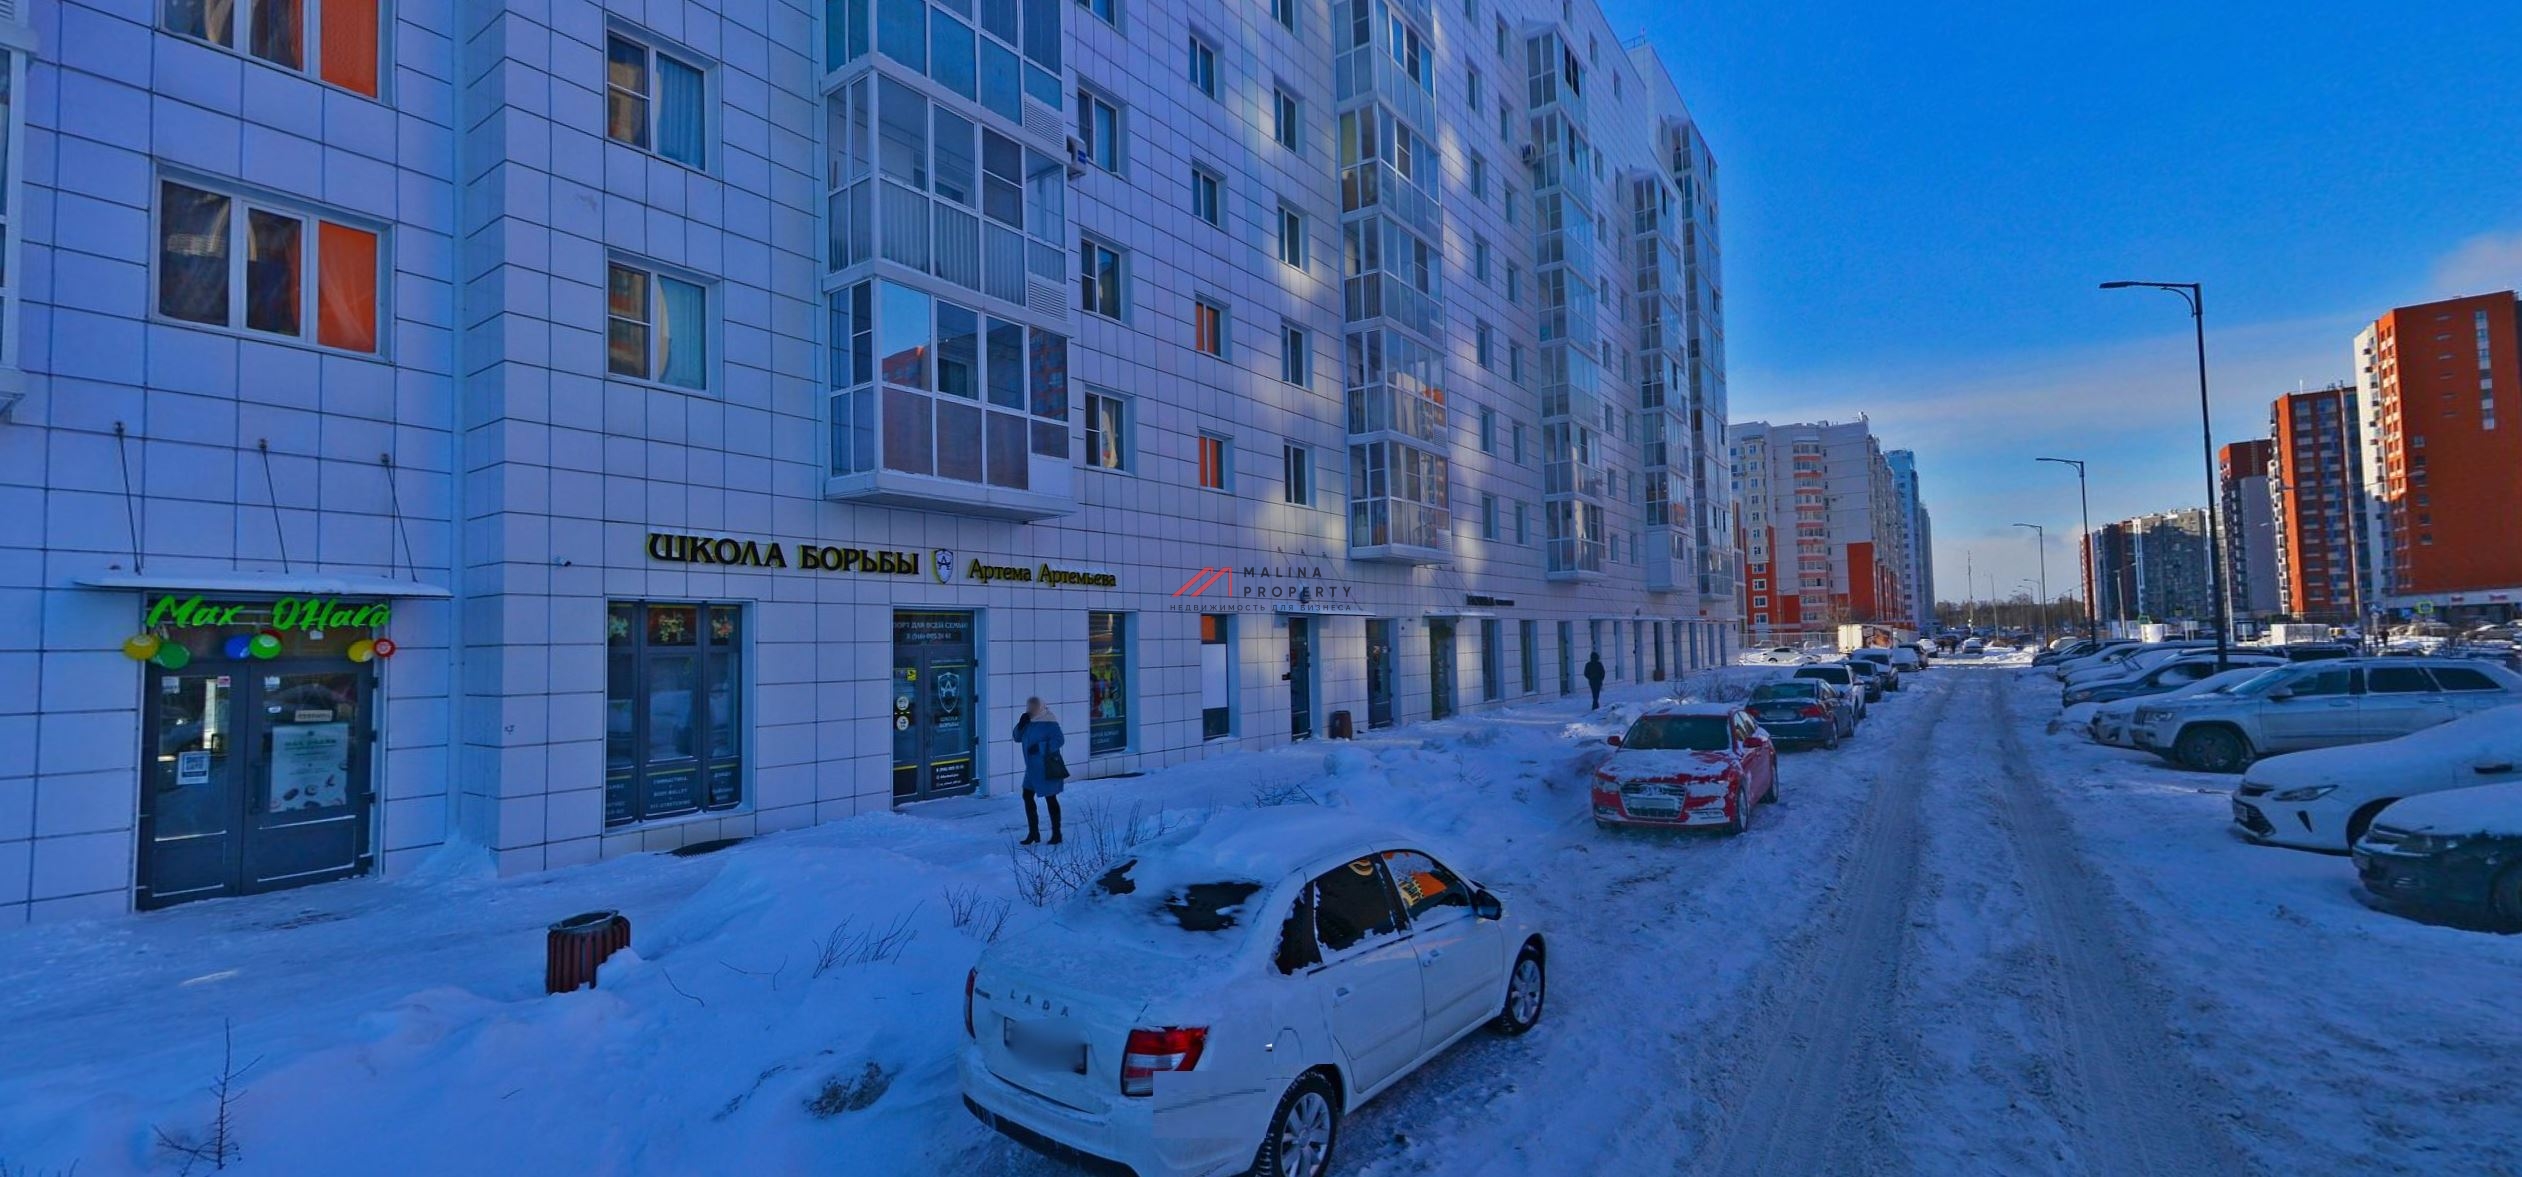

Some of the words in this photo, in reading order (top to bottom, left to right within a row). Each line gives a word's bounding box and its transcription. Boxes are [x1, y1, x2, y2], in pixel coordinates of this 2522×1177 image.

[647, 532, 787, 568] ШКОЛА
[797, 544, 920, 575] БОРЬБЫ
[968, 557, 1032, 584] Артема
[1038, 562, 1117, 588] Артемьева
[145, 594, 245, 629] Max
[1009, 988, 1070, 1017] LADA
